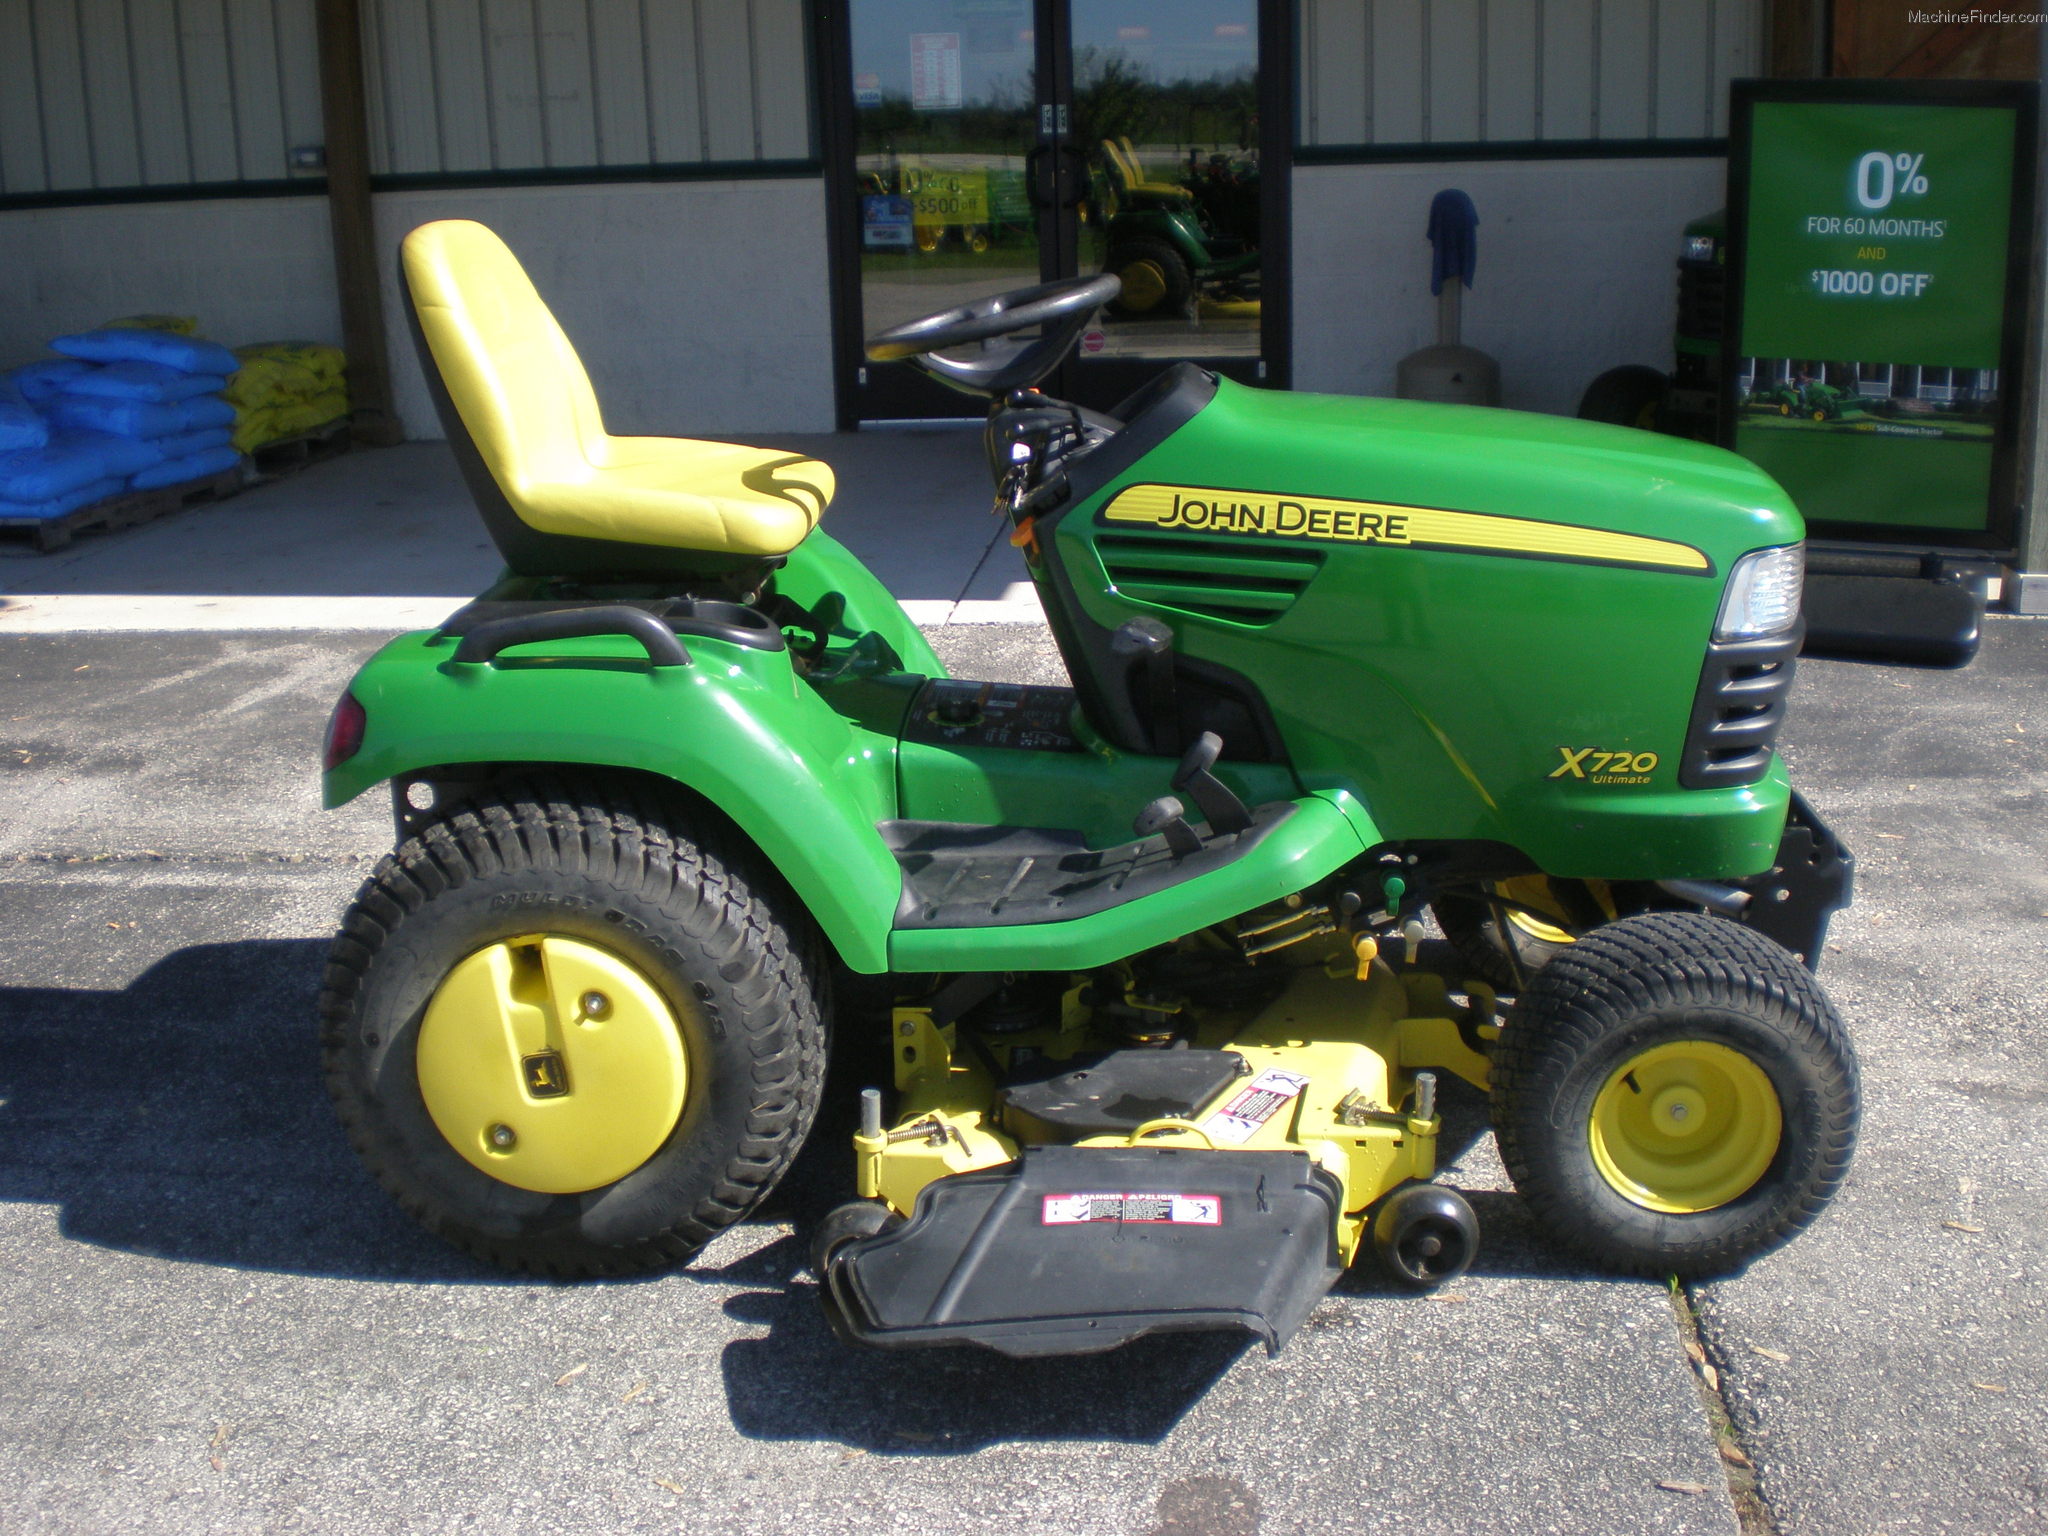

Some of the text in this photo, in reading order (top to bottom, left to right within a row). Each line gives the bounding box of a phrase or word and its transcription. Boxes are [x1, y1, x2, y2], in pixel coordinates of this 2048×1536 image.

[1857, 151, 1929, 209] 0%
[1808, 217, 1841, 234] FOR
[1844, 218, 1865, 235] 60
[1868, 218, 1945, 238] MONTHS
[1857, 247, 1887, 260] AND
[1812, 270, 1874, 295] $1000
[1880, 272, 1929, 297] OFF
[1158, 494, 1410, 541] JOHN DEERE
[1546, 747, 1659, 778] X720
[1593, 775, 1651, 784] Ultimate
[1082, 1193, 1183, 1201] DANGER PELIGRO
